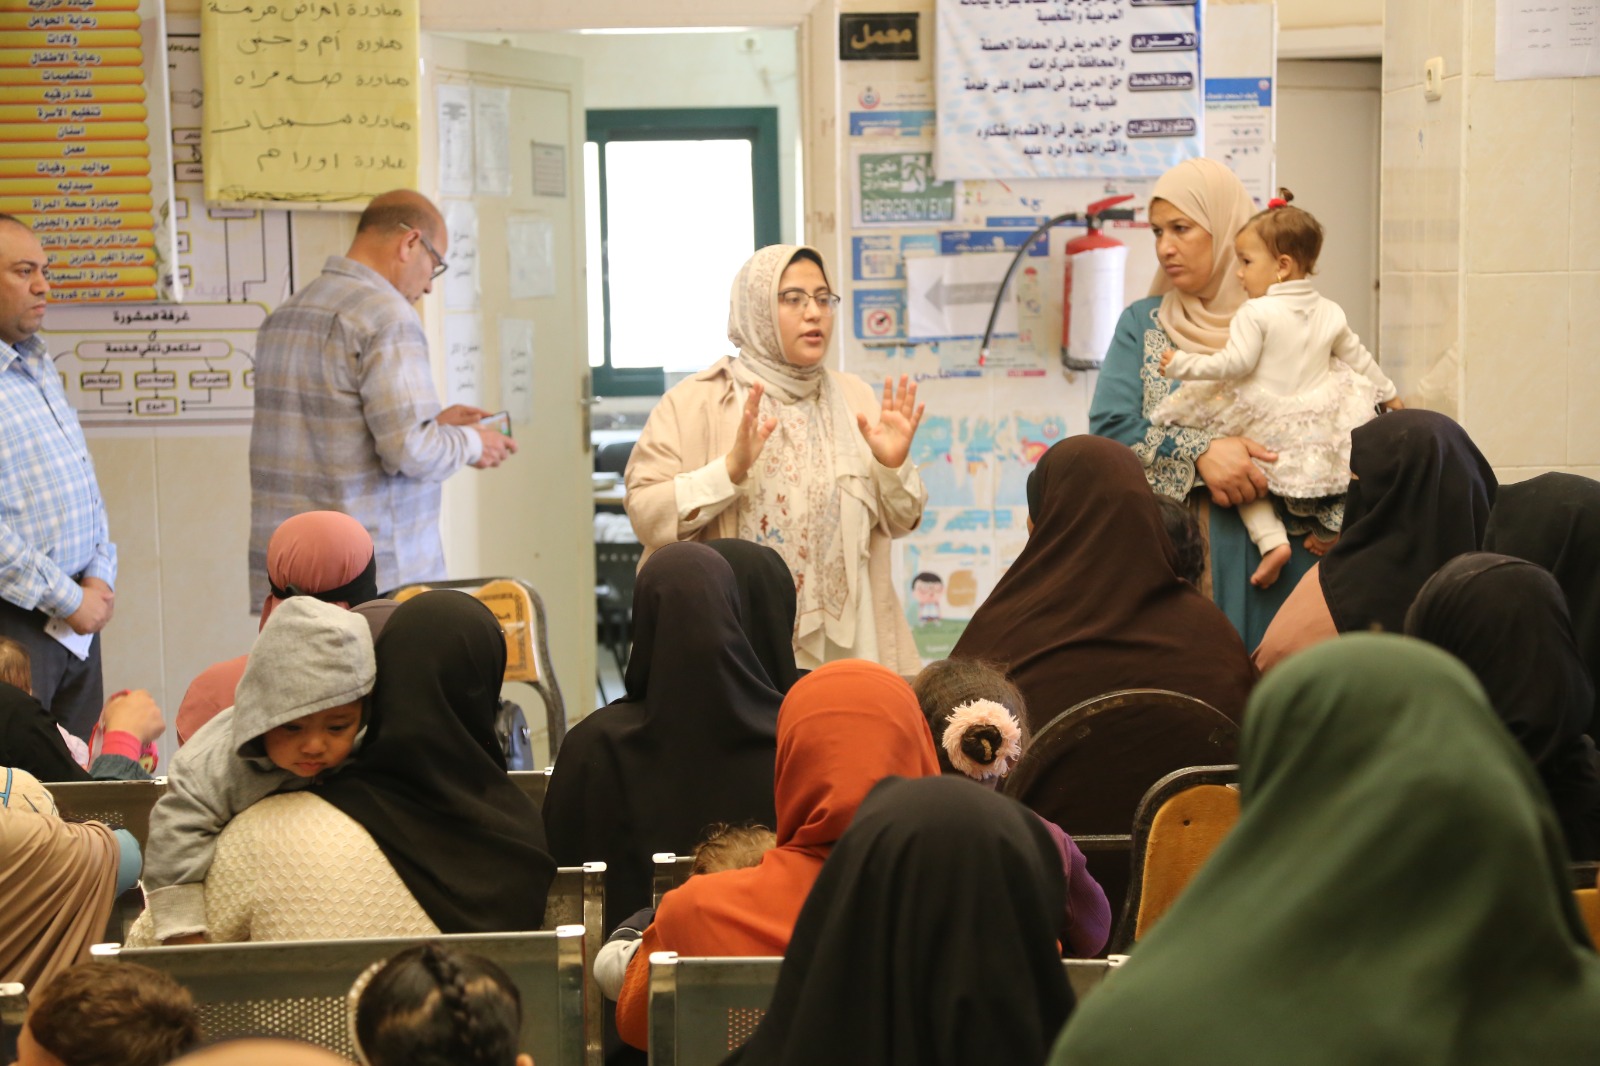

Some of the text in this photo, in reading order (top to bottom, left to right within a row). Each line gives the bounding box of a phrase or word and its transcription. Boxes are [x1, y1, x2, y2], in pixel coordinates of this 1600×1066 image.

[29, 13, 97, 28] رعاية الحوامل
[47, 33, 77, 47] ولادات
[850, 23, 913, 49] معمل
[1069, 37, 1107, 53] المريض
[74, 51, 101, 66] رعاية
[42, 71, 92, 85] التطعيمات
[1069, 76, 1106, 92] المريض
[1068, 122, 1106, 137] المريض
[63, 145, 86, 156] معمل
[37, 162, 66, 174] وفيات
[80, 162, 111, 174] مواليد
[90, 198, 119, 211] مبادرة
[862, 197, 954, 222] EMERGENCY EXIT
[93, 216, 122, 229] مبادرة
[90, 271, 118, 283] مبادرة
[113, 309, 190, 325] غرفة المشورة
